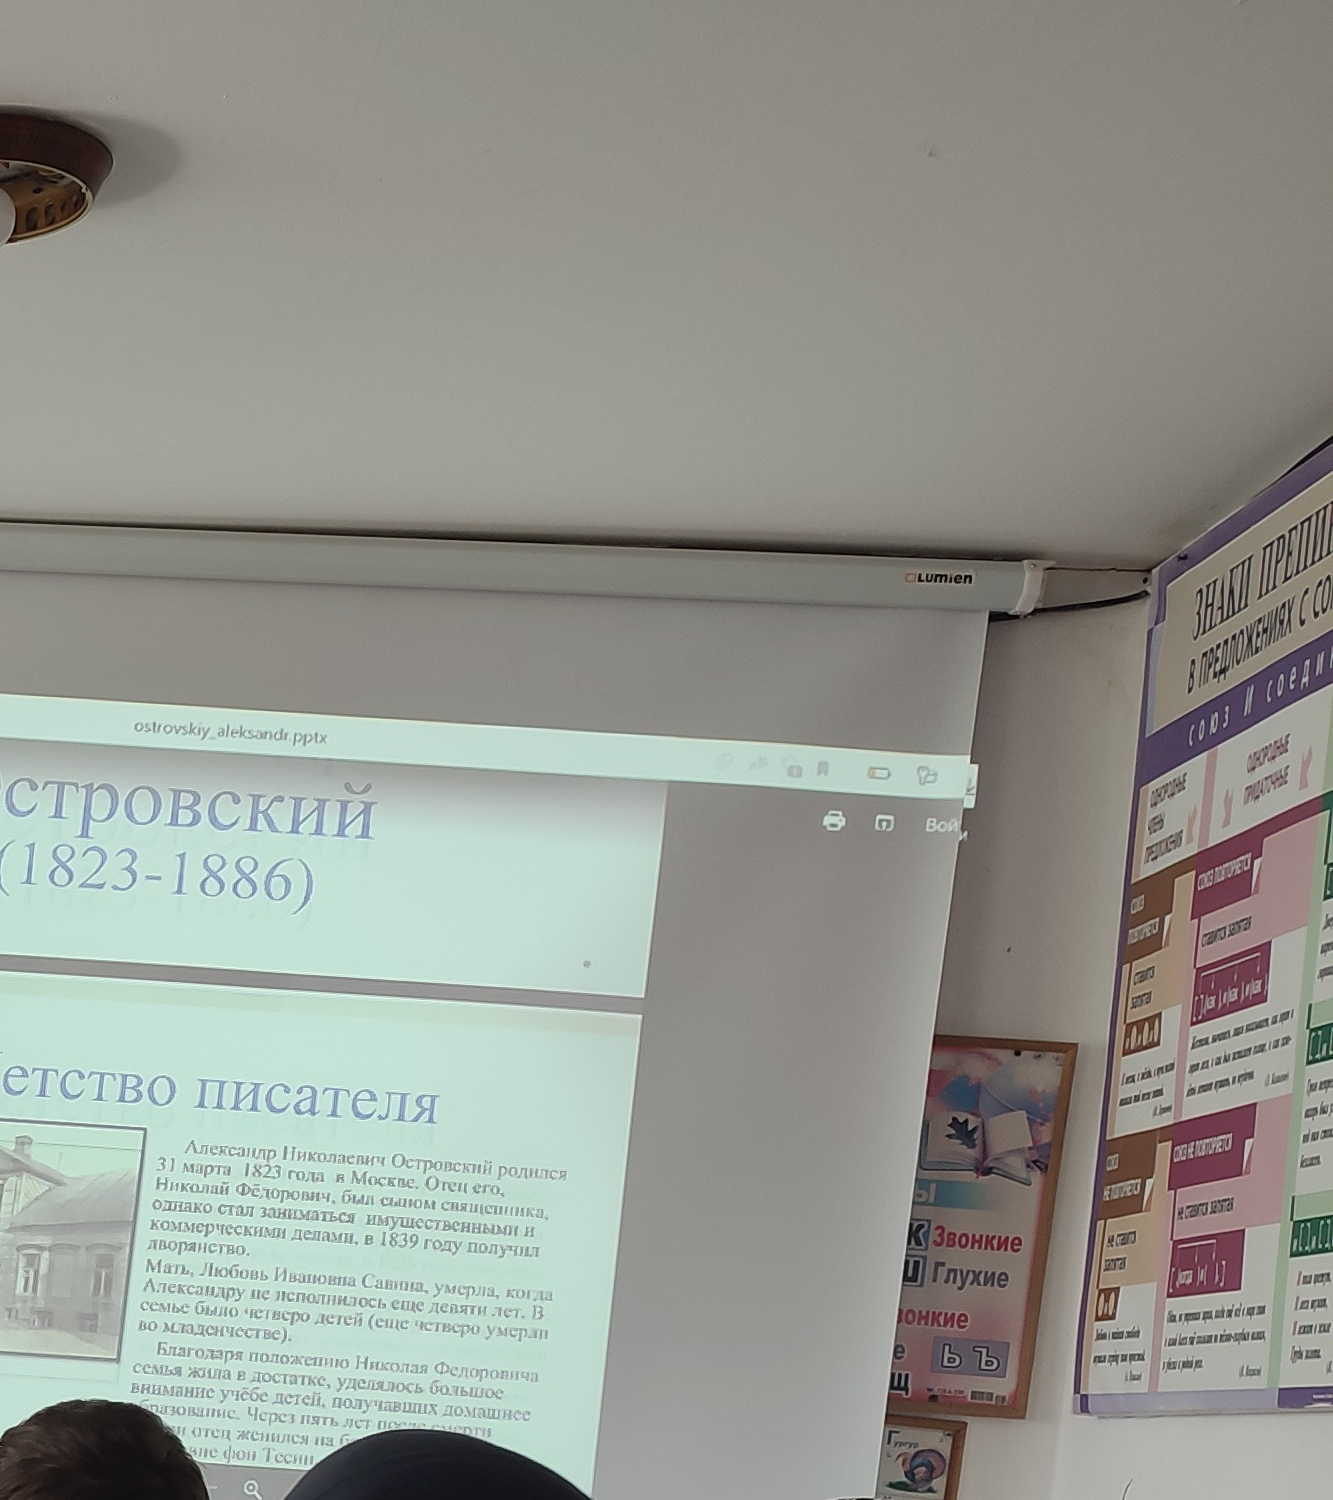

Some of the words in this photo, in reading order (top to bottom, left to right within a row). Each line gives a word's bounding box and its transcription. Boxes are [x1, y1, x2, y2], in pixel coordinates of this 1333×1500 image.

[917, 573, 973, 585] Lumien
[1192, 554, 1255, 641] ЗНАКИ
[1187, 658, 1197, 695] В
[1198, 594, 1295, 688] ПРЕДЛОЖЕНИЯХ
[1298, 586, 1310, 628] С
[133, 719, 329, 746] ostrovskiy_aleksandr.pptx
[1188, 704, 1231, 747] союз
[1243, 684, 1255, 717] И
[197, 1077, 441, 1125] писателя
[156, 1157, 176, 1172] 31
[183, 1161, 232, 1178] марта
[244, 1162, 282, 1179] 1823
[287, 1169, 325, 1183] года
[335, 1172, 346, 1183] в
[351, 1170, 420, 1189] Москве.
[425, 1176, 468, 1195] Отец
[472, 1184, 506, 1198] его,
[184, 1140, 278, 1161] Александр
[282, 1145, 386, 1167] Николаевич
[391, 1153, 493, 1175] Островский
[497, 1164, 568, 1181] родился
[152, 1198, 213, 1215] однако
[217, 1202, 255, 1218] стал
[260, 1206, 357, 1225] заниматься
[366, 1213, 520, 1237] имущественными
[523, 1225, 536, 1238] и
[155, 1177, 231, 1197] Николай
[341, 1189, 375, 1206] был
[380, 1195, 437, 1211] сыном
[441, 1200, 550, 1221] священника,
[149, 1218, 287, 1240] коммерческими
[290, 1228, 359, 1247] делами,
[363, 1233, 375, 1246] в
[380, 1232, 420, 1250] 1839
[423, 1239, 464, 1256] году
[466, 1241, 541, 1260] получил
[932, 1225, 1024, 1254] Звонкие
[145, 1257, 196, 1279] Мать,
[199, 1261, 270, 1282] Любовь
[274, 1266, 358, 1288] Ивановна
[361, 1273, 430, 1295] Савина,
[433, 1282, 501, 1301] умерла,
[505, 1288, 554, 1302] когда
[932, 1262, 1010, 1290] Глухие
[973, 1346, 1001, 1373] Ъ
